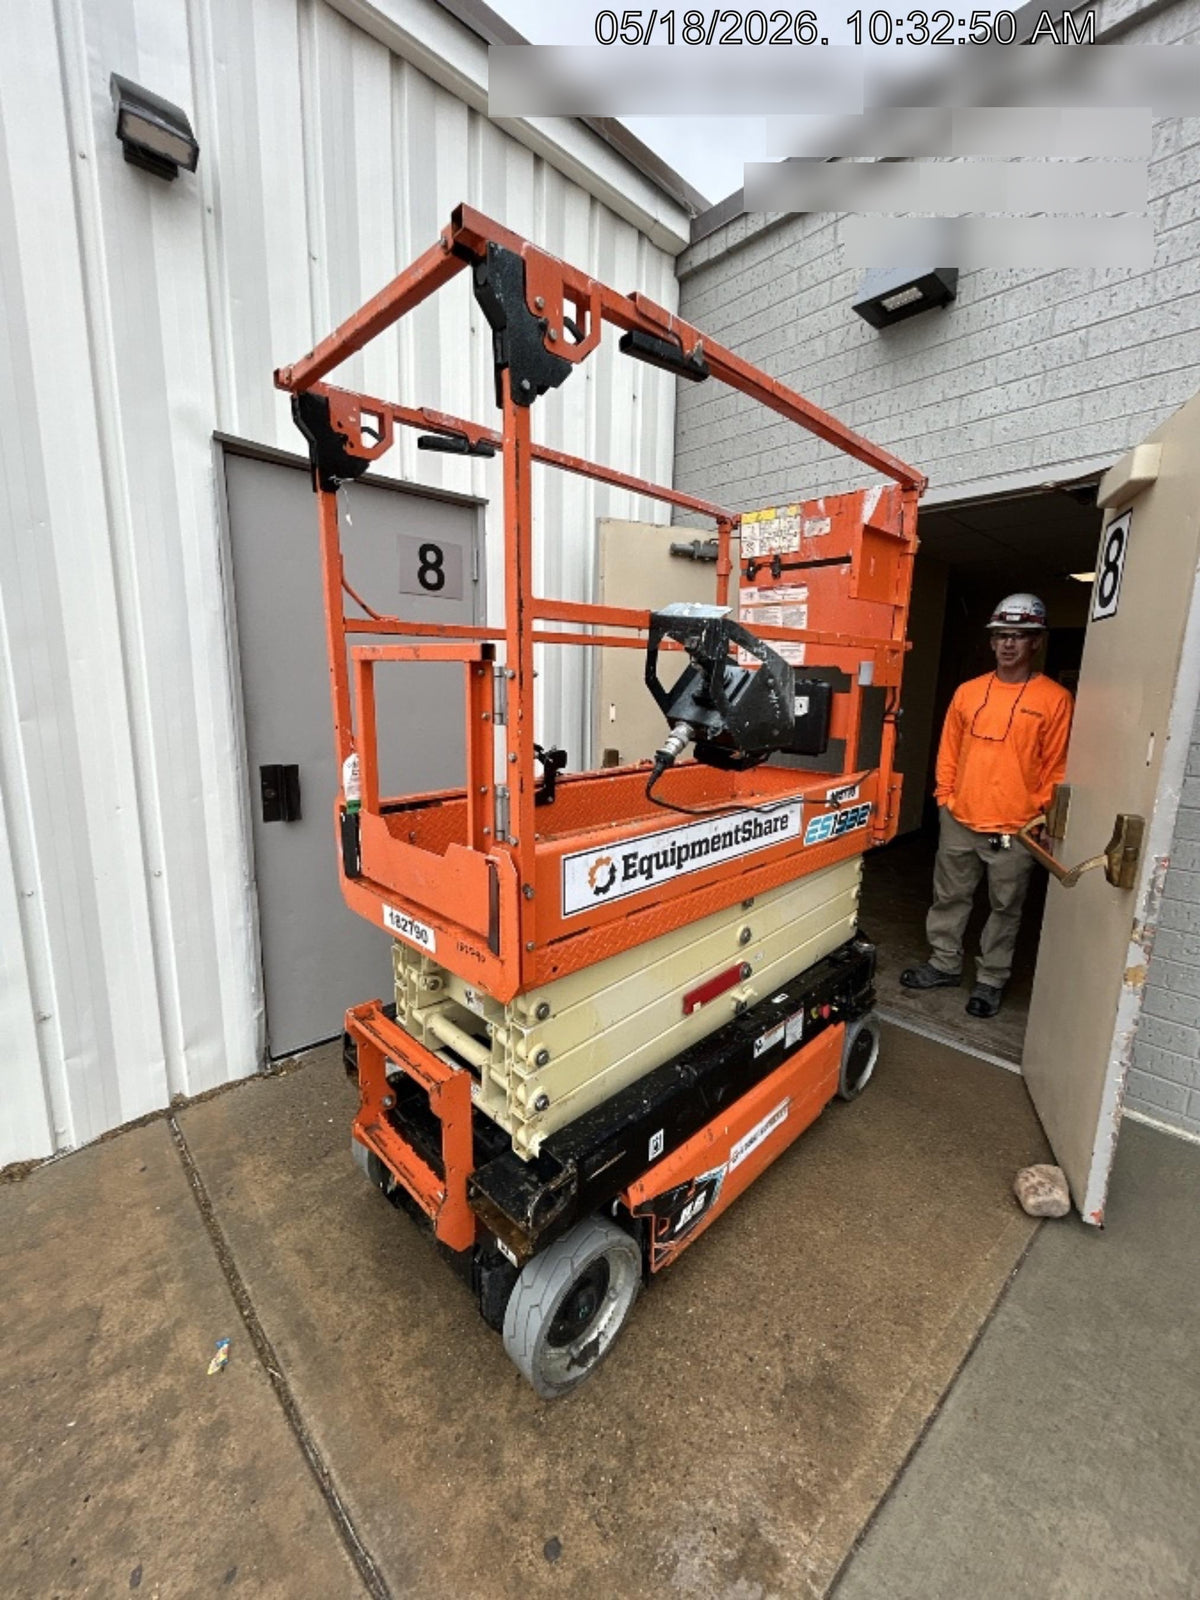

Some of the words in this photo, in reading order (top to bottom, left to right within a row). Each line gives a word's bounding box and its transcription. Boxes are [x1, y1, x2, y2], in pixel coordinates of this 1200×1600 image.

[417, 543, 446, 592] 8
[1098, 527, 1125, 608] 8
[621, 813, 789, 882] EquipmentShare
